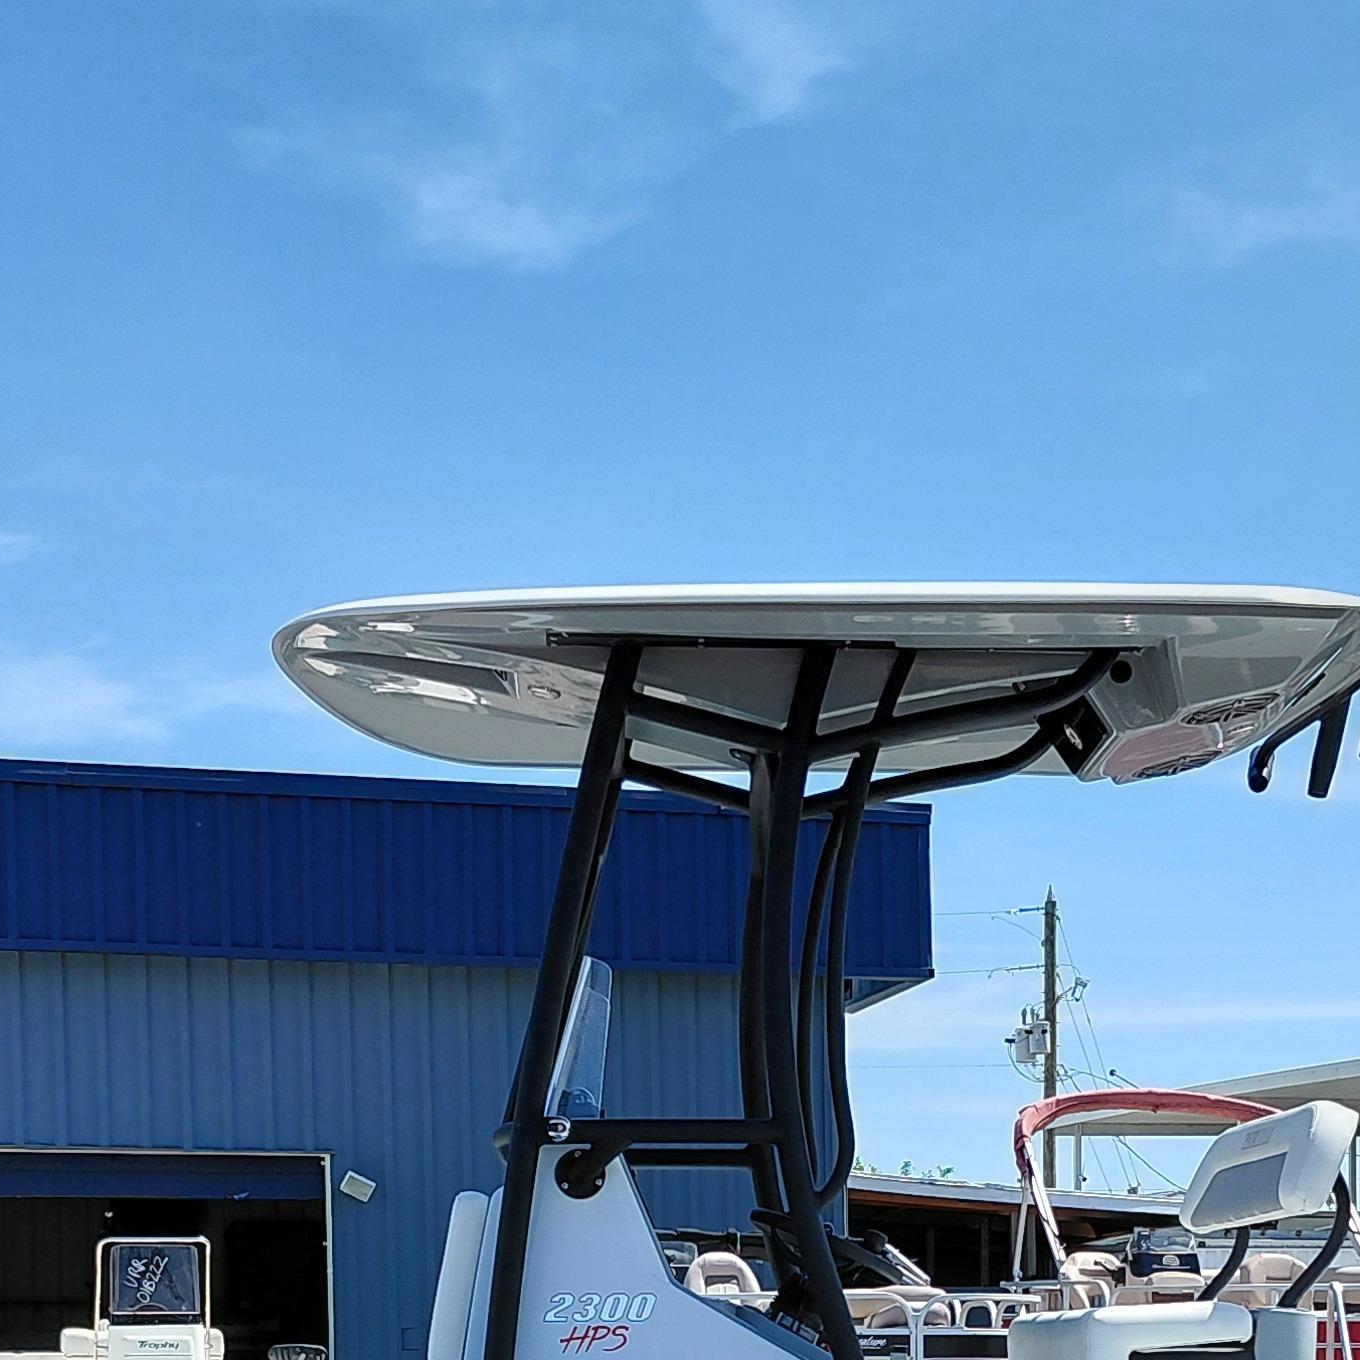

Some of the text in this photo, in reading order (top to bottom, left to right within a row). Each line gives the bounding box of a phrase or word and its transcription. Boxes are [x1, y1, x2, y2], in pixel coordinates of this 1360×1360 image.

[543, 1292, 657, 1323] 2300
[138, 1341, 180, 1350] Trophy
[559, 1325, 629, 1354] HPS
